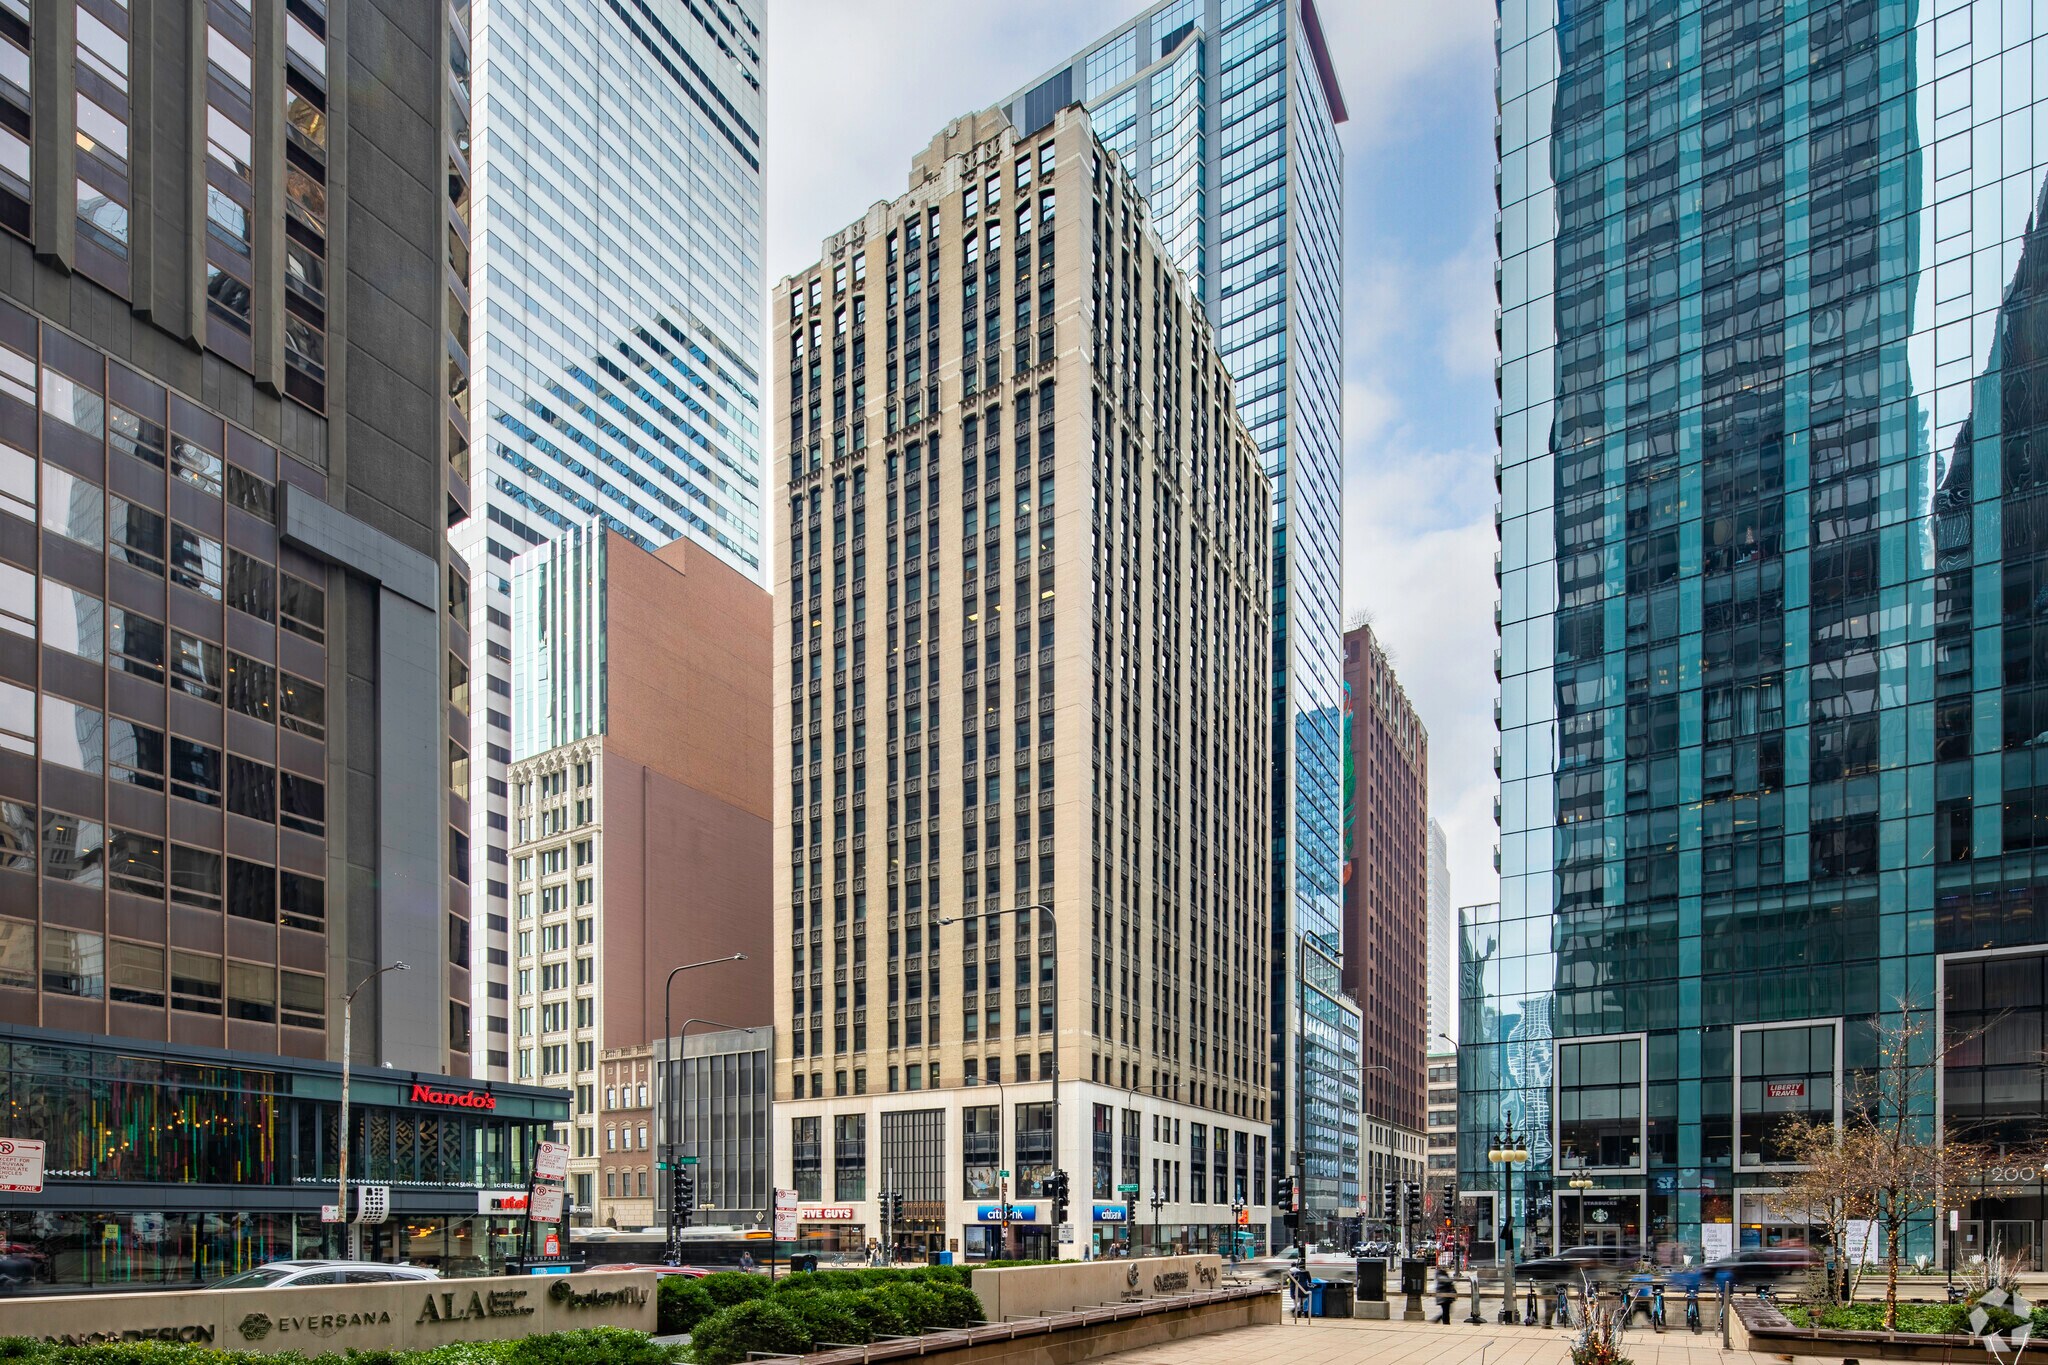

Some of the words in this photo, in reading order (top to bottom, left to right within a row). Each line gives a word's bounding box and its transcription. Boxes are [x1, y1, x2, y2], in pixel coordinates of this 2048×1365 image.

[1770, 1083, 1801, 1091] LIBERTY
[410, 1083, 496, 1109] Nando's
[1992, 1167, 2034, 1181] 200
[491, 1195, 528, 1209] nutel
[802, 1209, 823, 1218] FIVE
[824, 1209, 851, 1218] GUYS
[1101, 1209, 1122, 1220] citibank
[416, 1290, 486, 1323] ALA
[279, 1311, 391, 1331] EVERSANA
